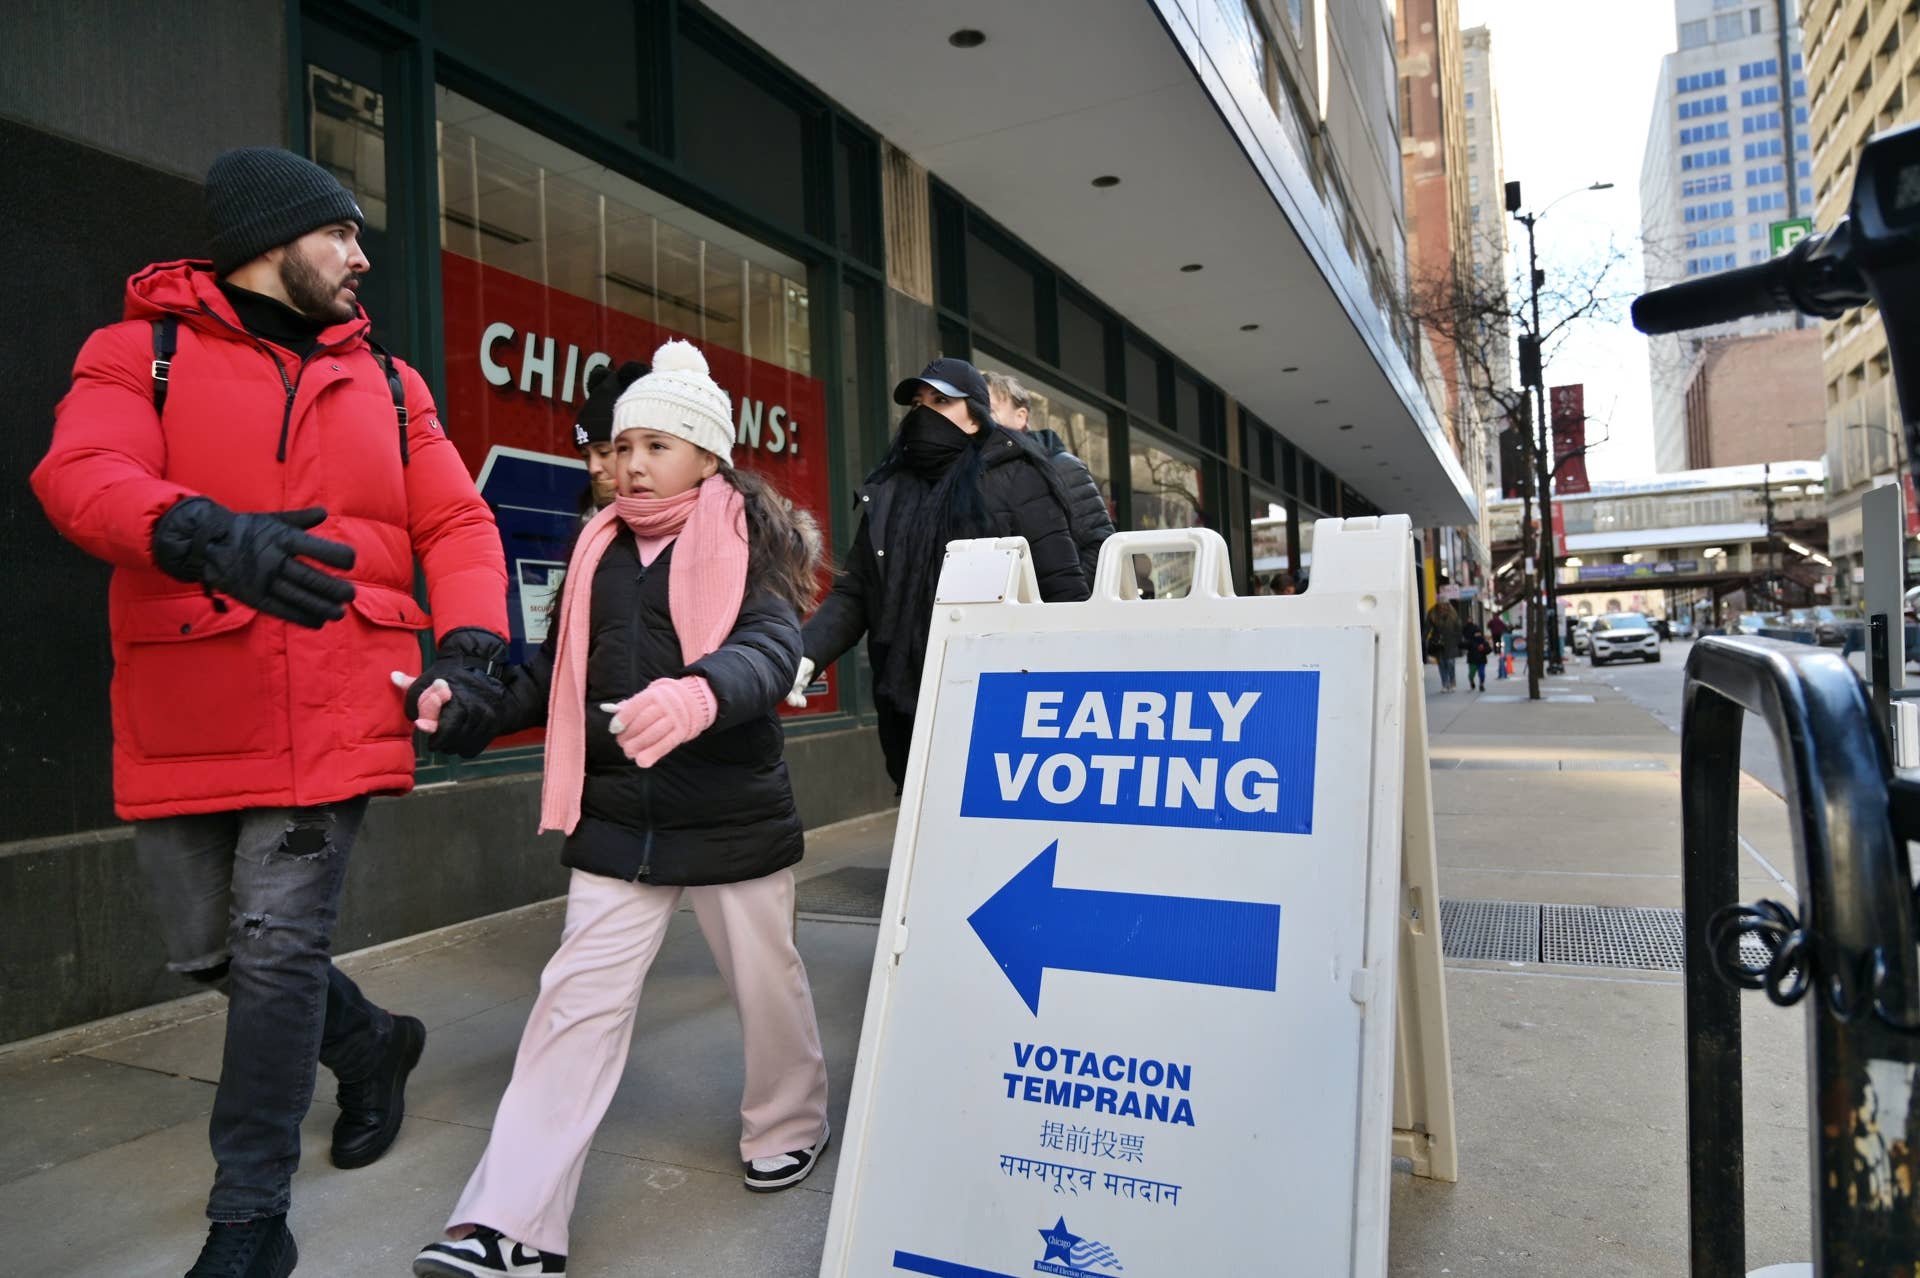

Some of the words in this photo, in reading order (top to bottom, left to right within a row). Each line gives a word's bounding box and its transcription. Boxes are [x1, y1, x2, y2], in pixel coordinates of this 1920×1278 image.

[480, 322, 798, 454] CHICNS:
[1021, 691, 1262, 743] EARLY
[994, 753, 1280, 813] VOTING
[1013, 1042, 1191, 1091] VOTACION
[1003, 1073, 1196, 1127] TEMPRANA
[1040, 1119, 1145, 1163] 提前投票
[1103, 1173, 1183, 1207] मतदान
[1047, 1235, 1071, 1249] Chicago
[1037, 1262, 1053, 1272] Board
